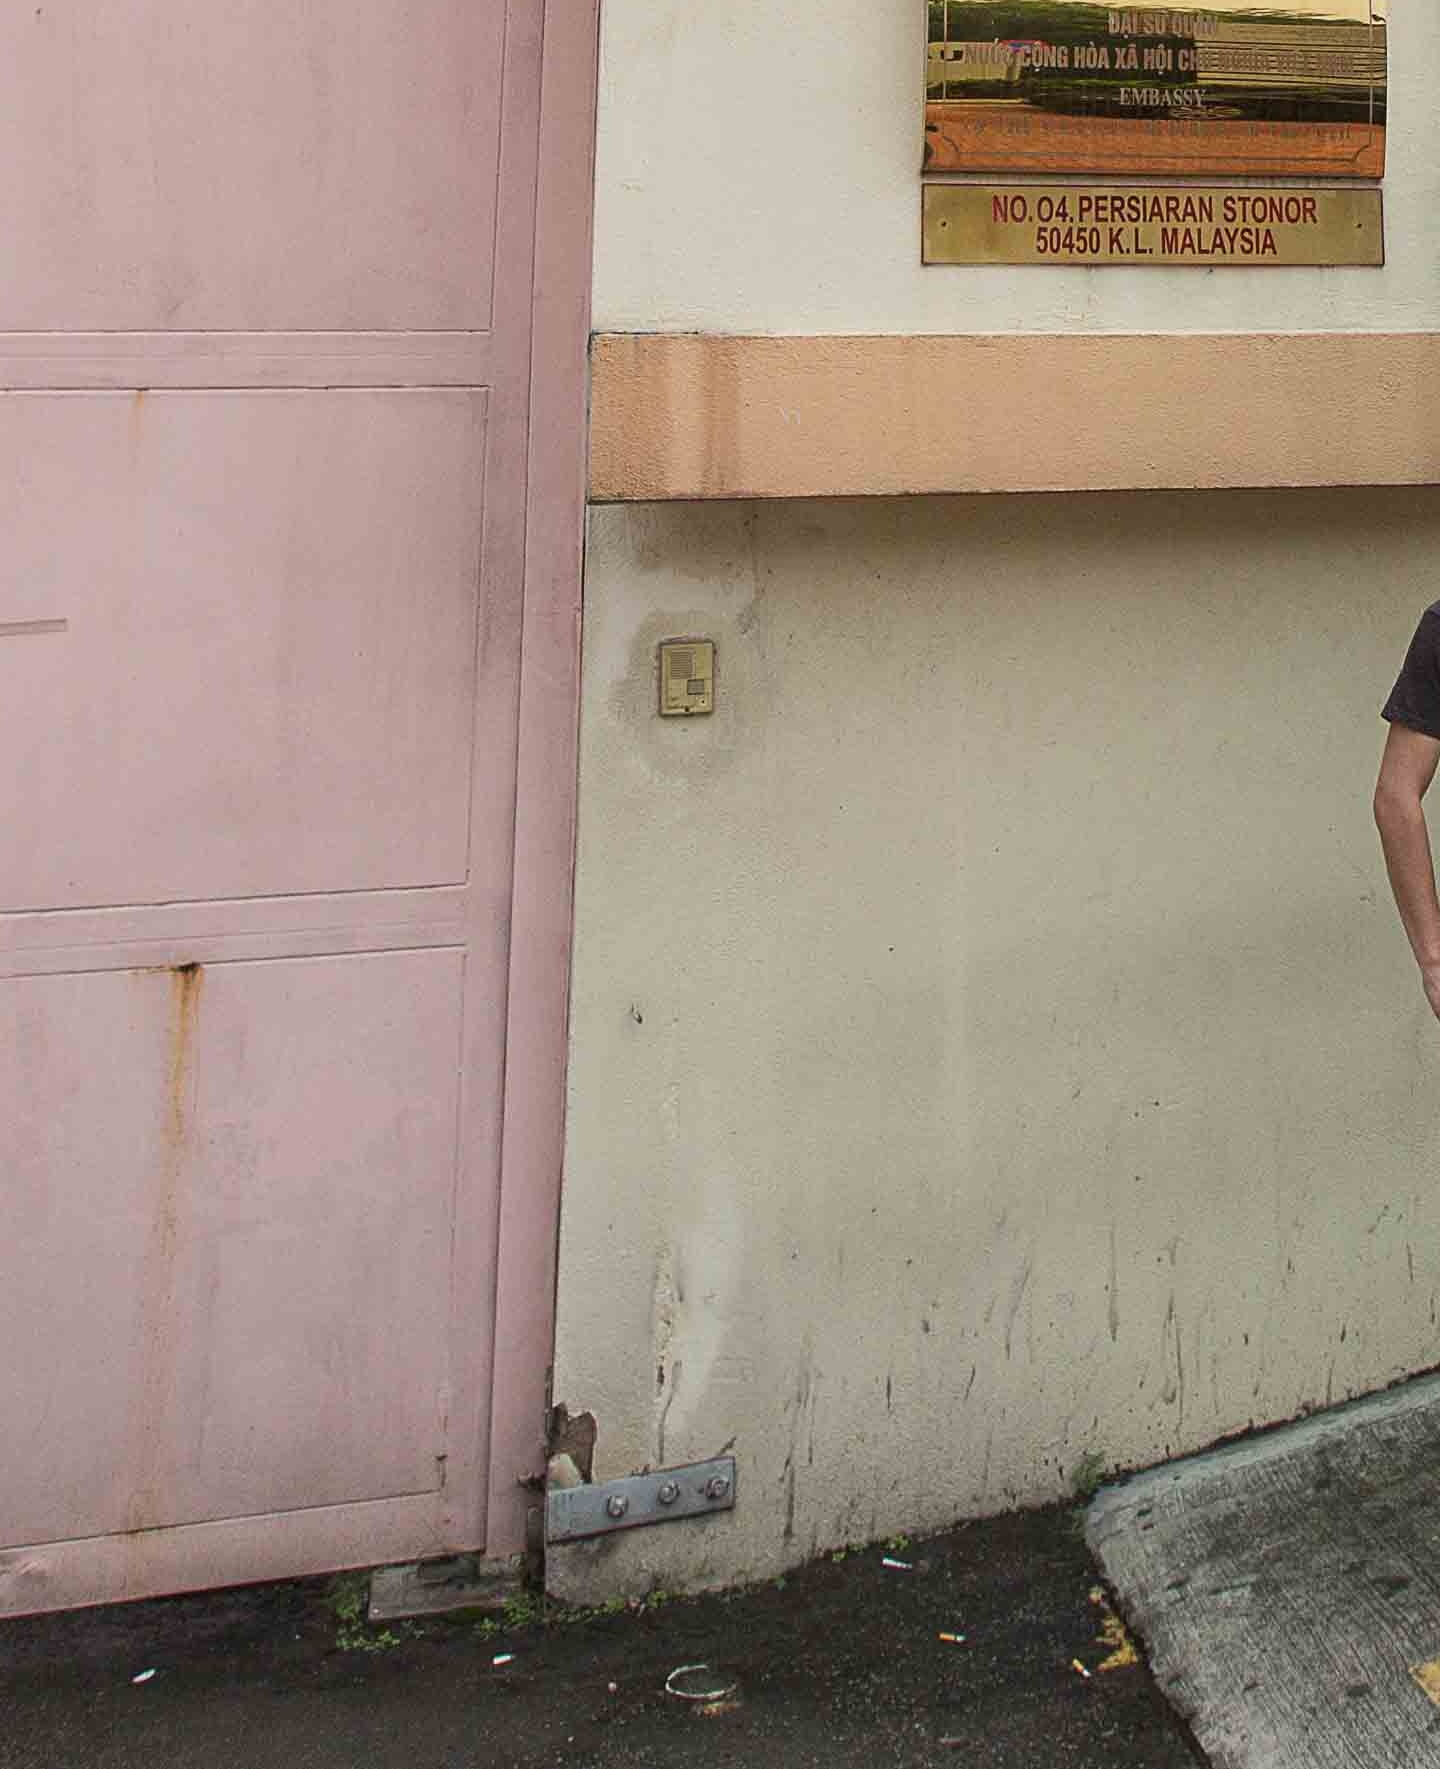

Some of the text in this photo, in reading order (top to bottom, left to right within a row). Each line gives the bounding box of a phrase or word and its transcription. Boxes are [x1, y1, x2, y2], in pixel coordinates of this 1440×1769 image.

[1022, 42, 1069, 72] CỘNG
[1074, 41, 1109, 70] HÒA
[1115, 44, 1139, 70] XÃ
[1144, 43, 1173, 75] HỘI
[1120, 87, 1207, 107] EMBASSY
[1222, 195, 1318, 225] STONOR
[1036, 226, 1101, 255] 50450
[1161, 228, 1278, 256] MALAYSIA
